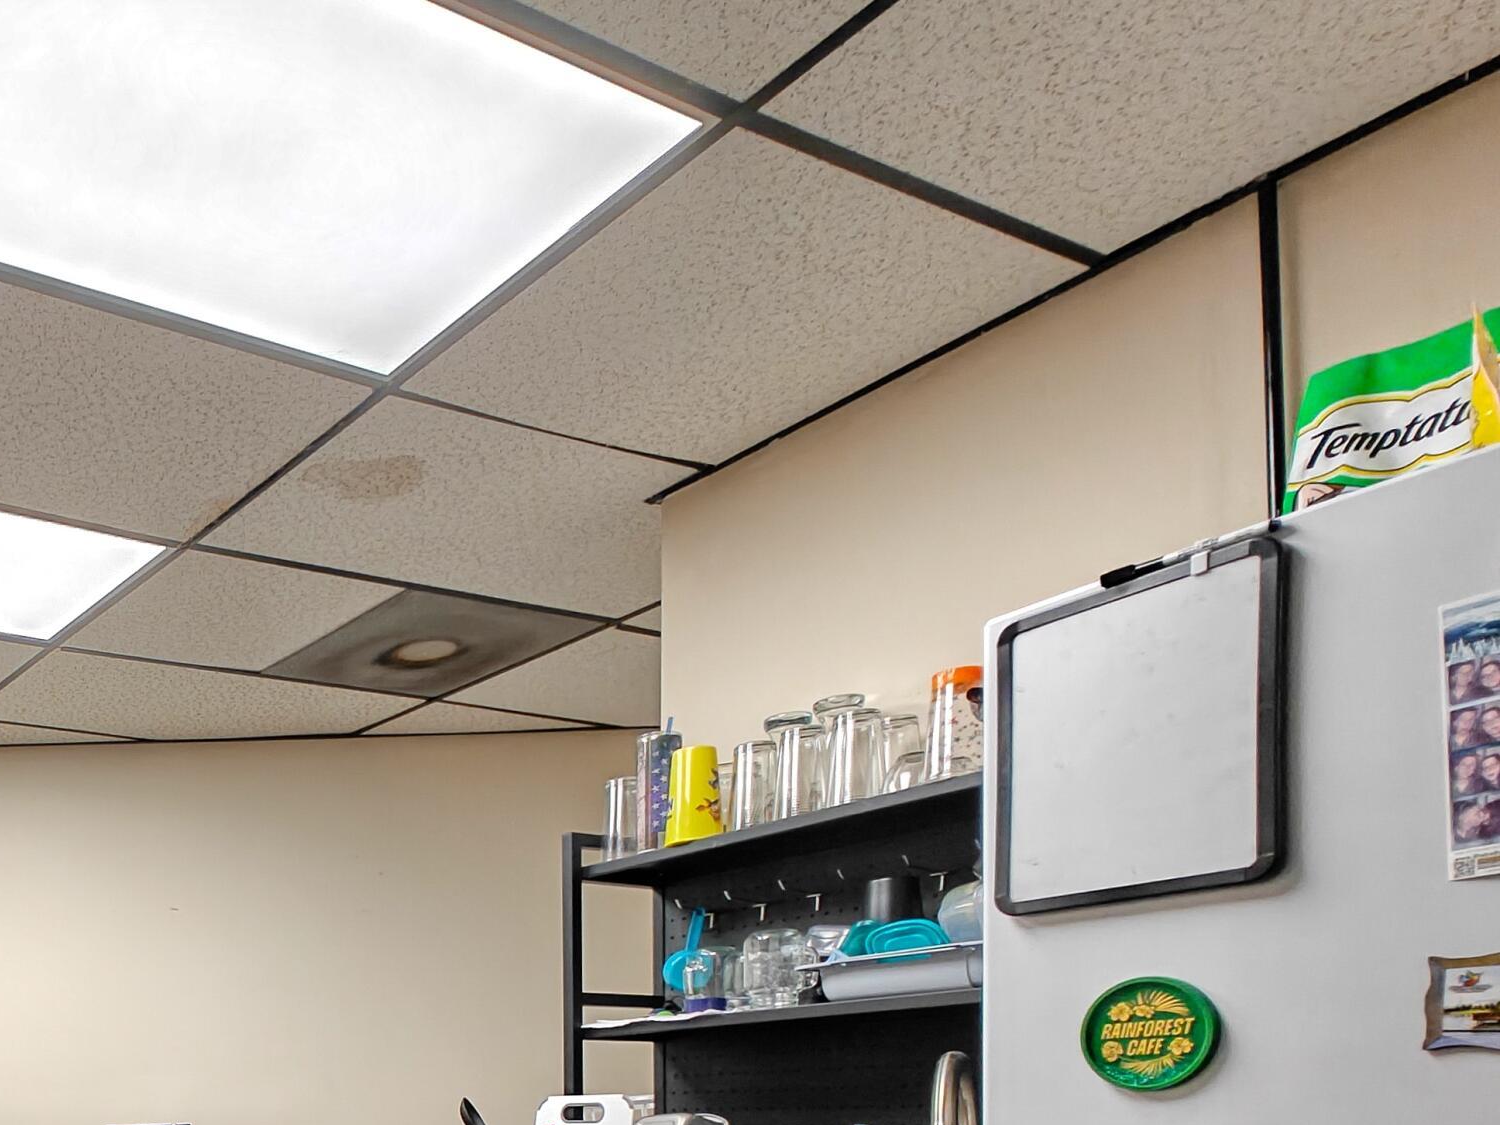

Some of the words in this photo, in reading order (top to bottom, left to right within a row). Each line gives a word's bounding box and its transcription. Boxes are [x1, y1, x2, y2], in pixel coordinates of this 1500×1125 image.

[1306, 397, 1471, 470] Temptati
[1100, 1017, 1196, 1040] RAINFOREST
[1126, 1038, 1165, 1056] CAFE
